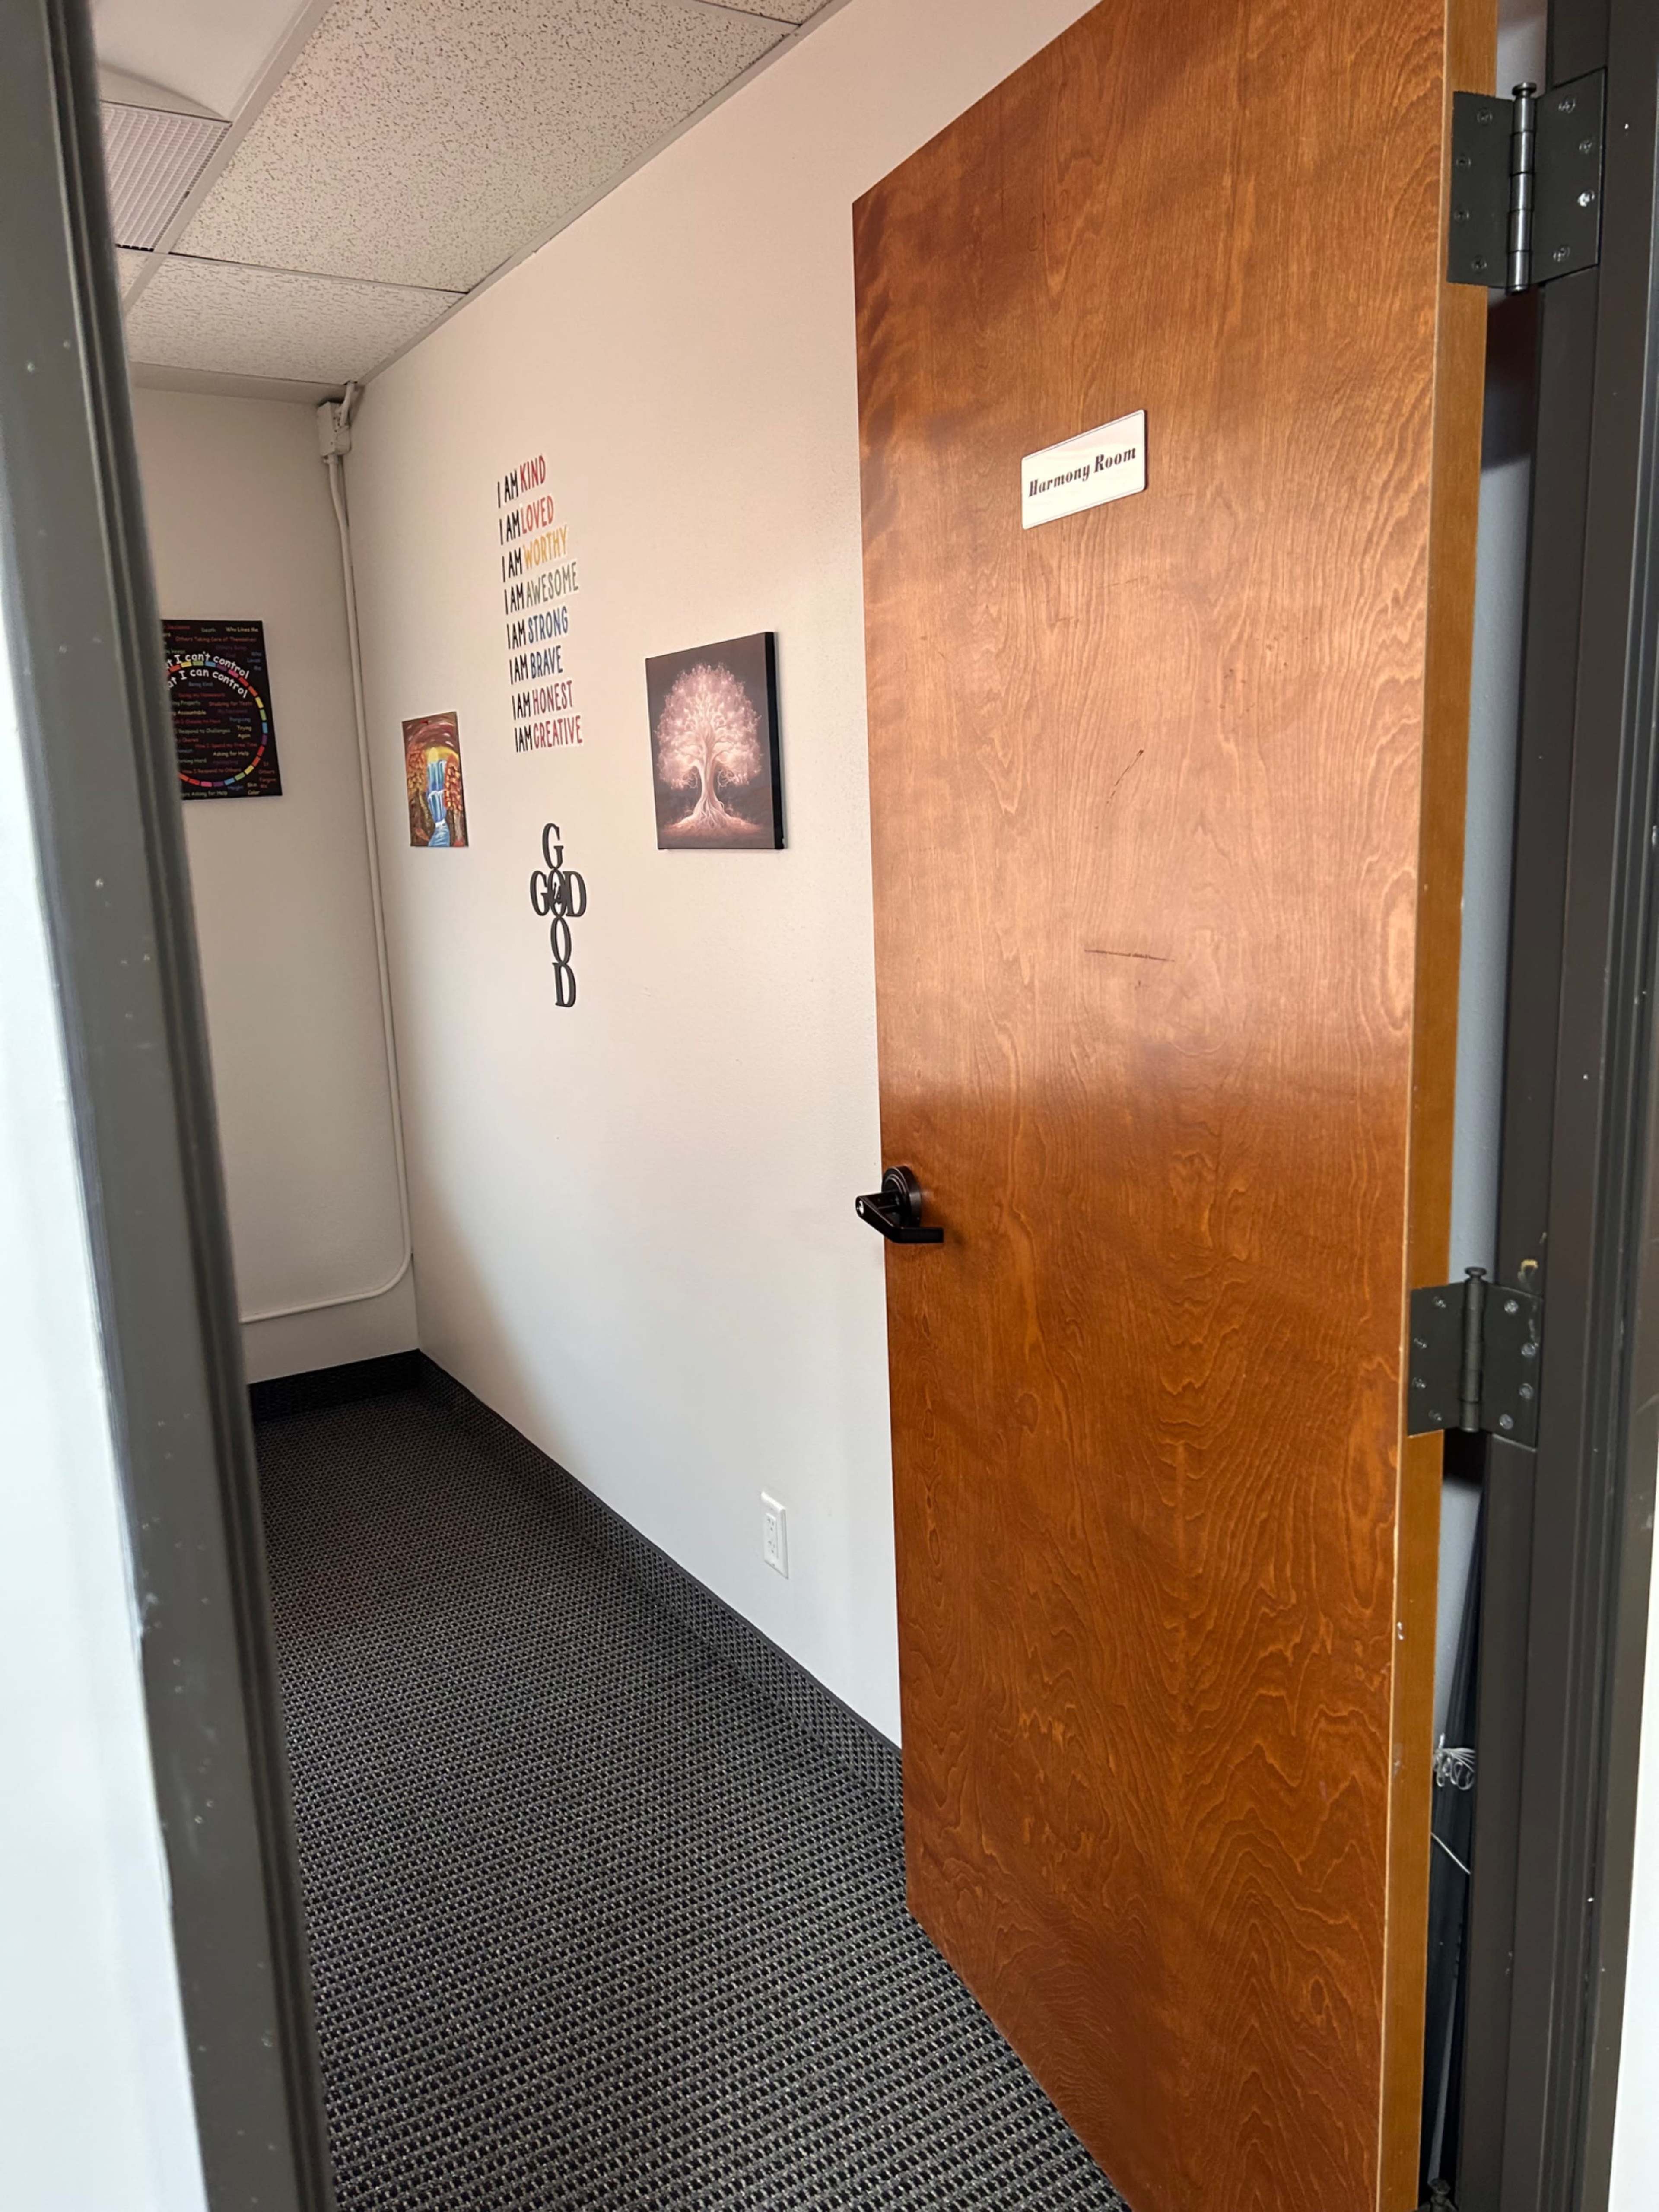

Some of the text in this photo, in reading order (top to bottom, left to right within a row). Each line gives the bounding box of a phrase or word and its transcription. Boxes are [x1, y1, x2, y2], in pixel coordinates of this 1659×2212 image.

[497, 455, 546, 509] I AM KIND
[1028, 448, 1136, 497] Harmony Room
[499, 496, 554, 546] I AM LOVED
[502, 526, 566, 583] I AM WORTHY
[504, 562, 579, 615] I AM AWESOME
[506, 606, 568, 650] I AM STRONG
[179, 671, 187, 680] I
[212, 671, 248, 698] control
[185, 651, 211, 661] can't
[213, 656, 249, 679] control
[509, 645, 563, 686] I AM BRAVE
[512, 680, 572, 721] I AM HONEST
[514, 715, 582, 753] I AM CREATIVE
